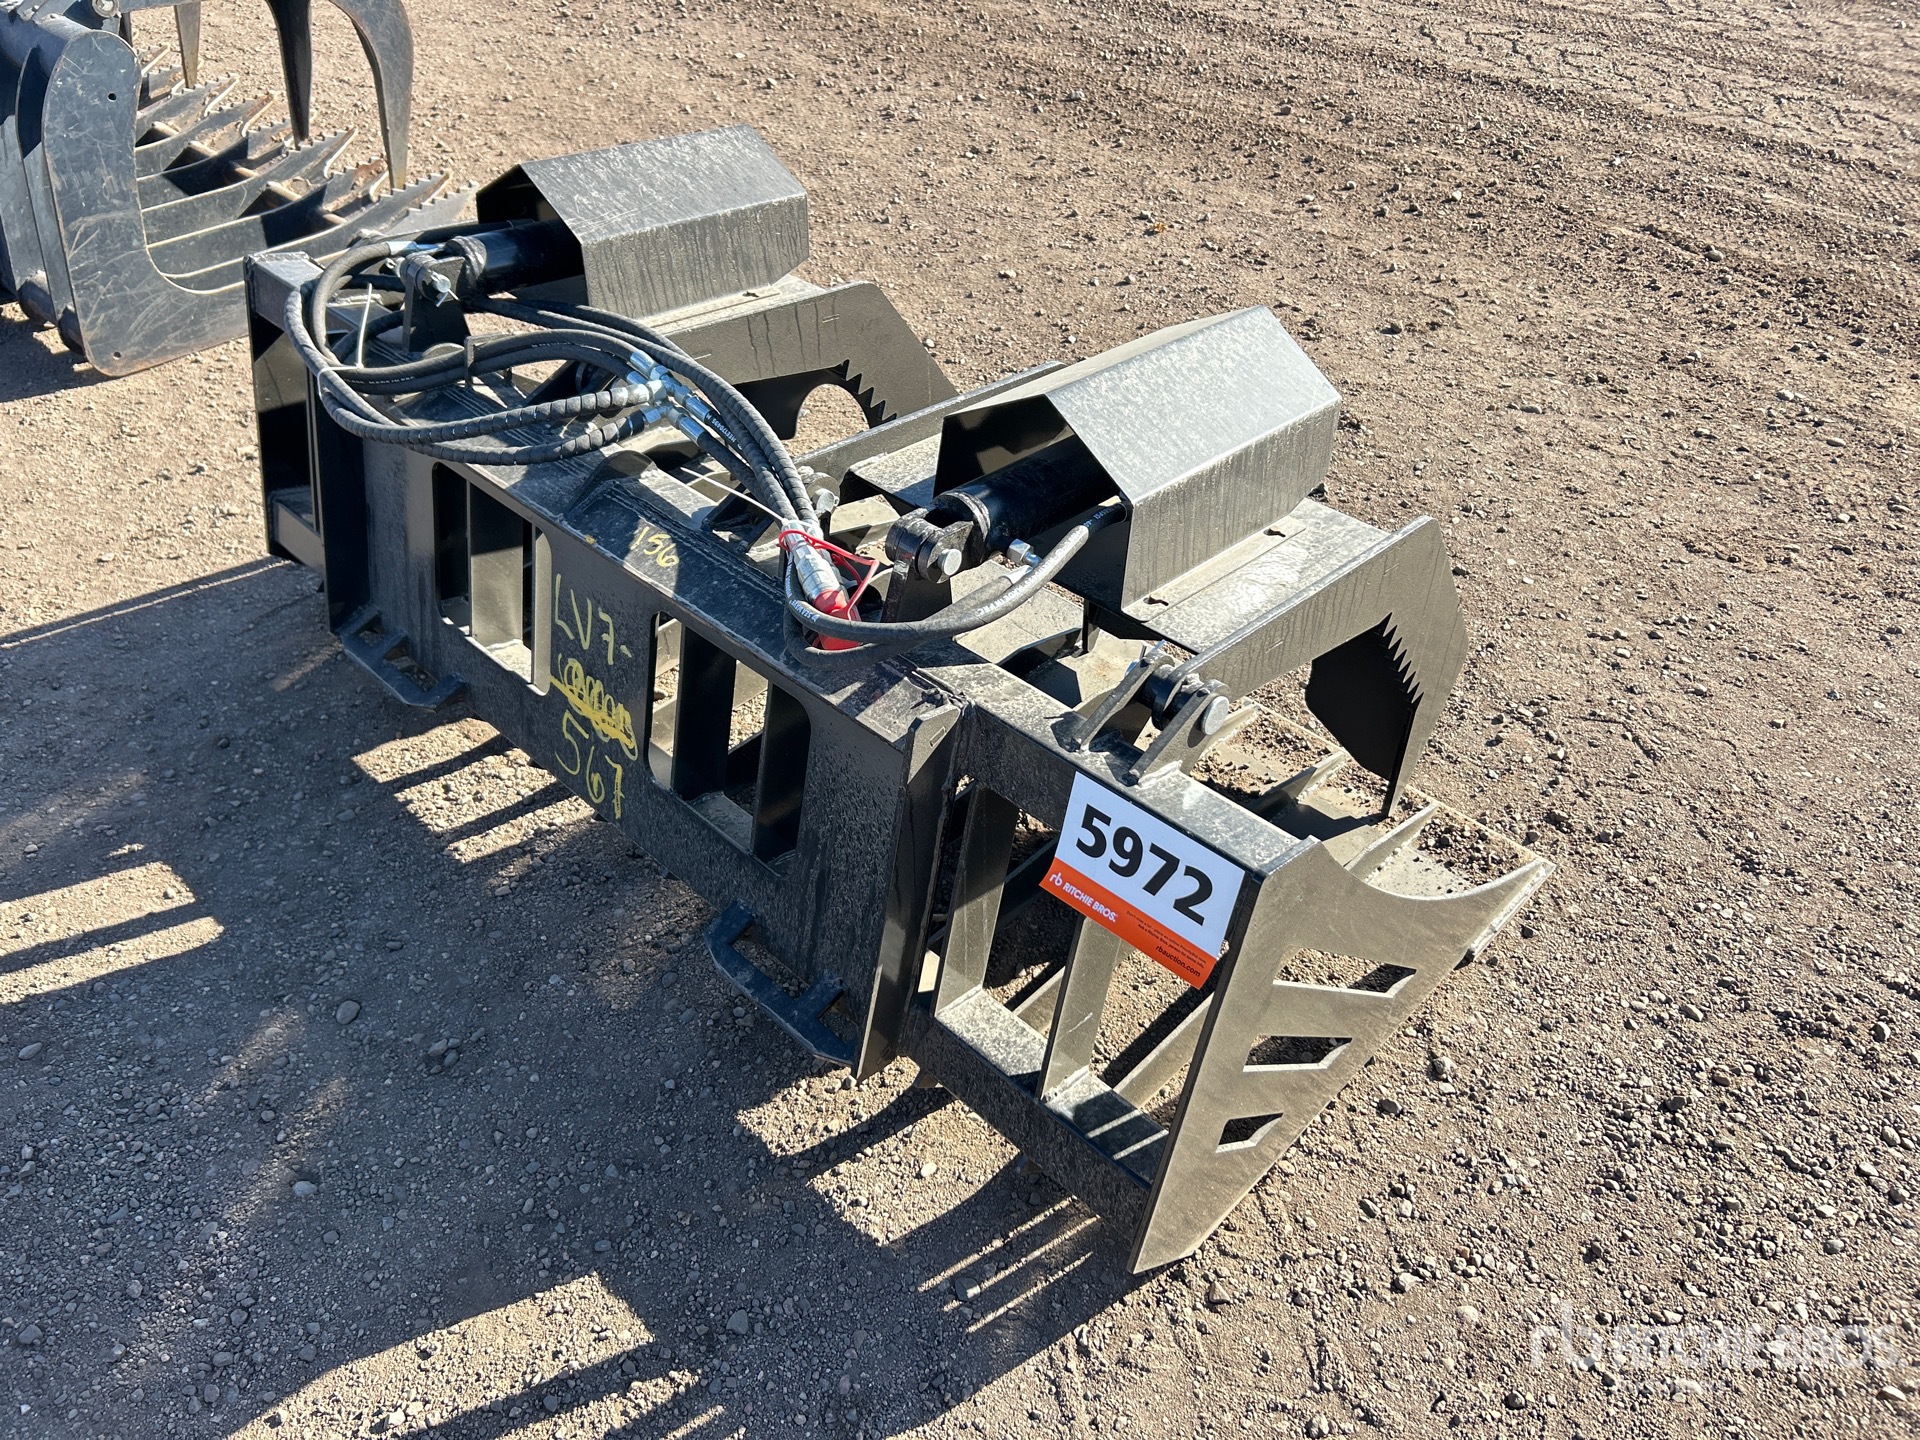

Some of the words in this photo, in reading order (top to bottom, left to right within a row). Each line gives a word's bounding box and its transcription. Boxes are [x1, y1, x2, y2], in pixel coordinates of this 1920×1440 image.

[629, 525, 679, 568] 156
[555, 709, 626, 819] 567
[1075, 803, 1213, 926] 5972
[1062, 882, 1093, 906] RITCHIE
[1155, 945, 1201, 977] rbauction.com
